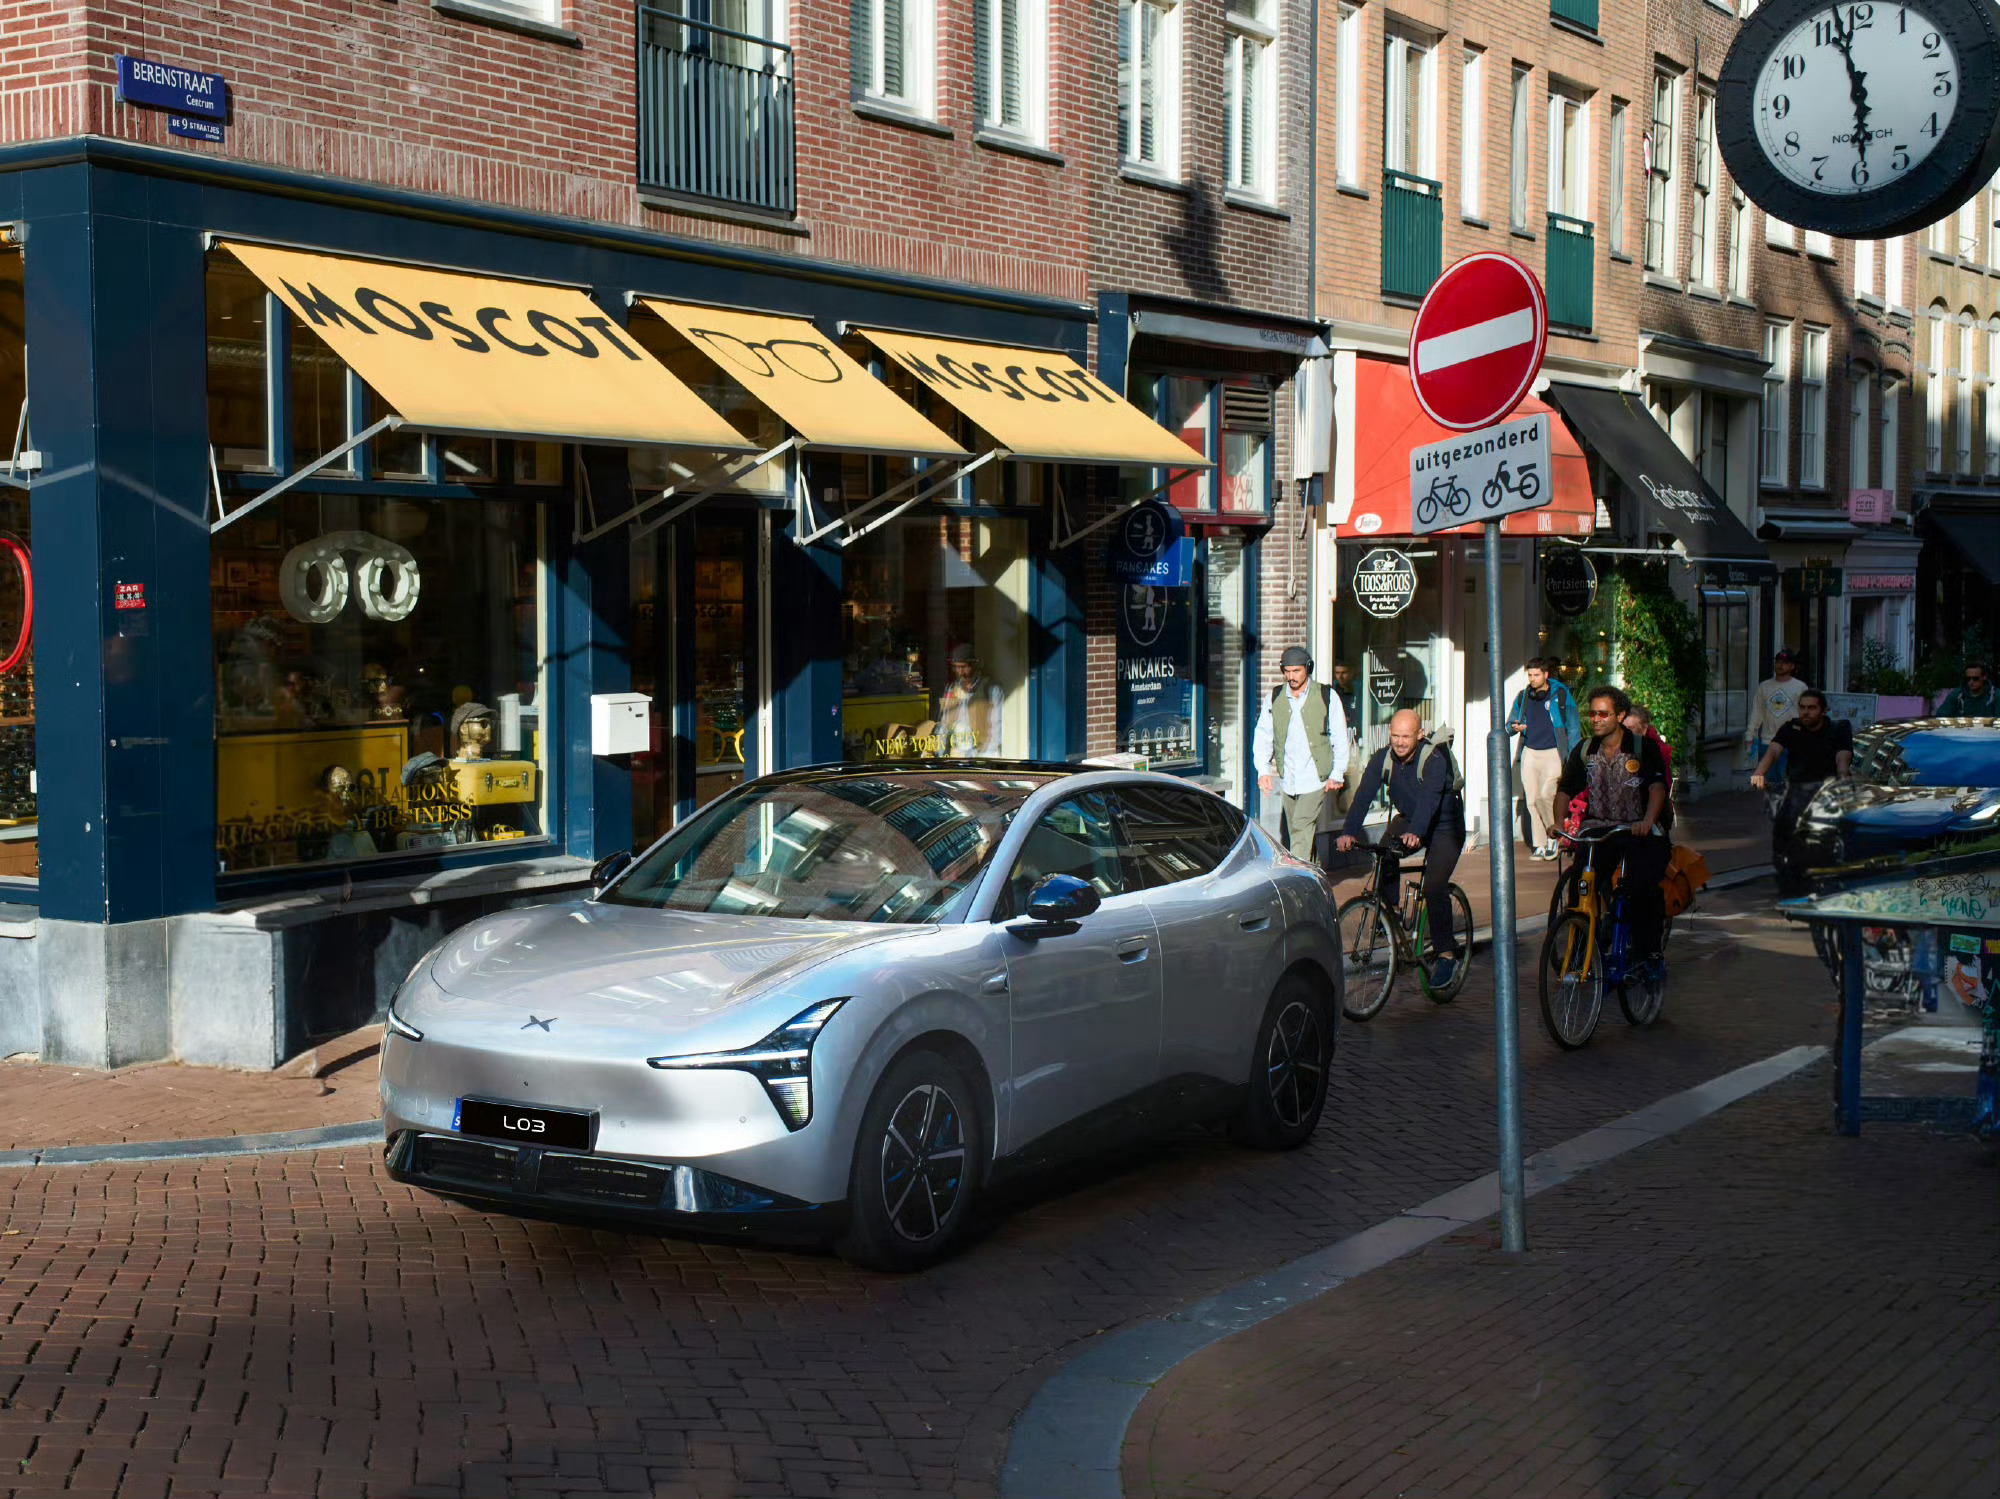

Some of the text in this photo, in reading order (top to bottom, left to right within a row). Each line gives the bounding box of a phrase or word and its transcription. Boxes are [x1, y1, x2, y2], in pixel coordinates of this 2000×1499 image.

[1811, 20, 1833, 47] 11
[1922, 33, 1941, 59] 2
[133, 61, 214, 95] BERENSTRAAT
[1780, 54, 1805, 80] 10
[1933, 70, 1952, 97] 3
[186, 94, 215, 110] Centrum
[1773, 94, 1790, 119] 9
[172, 118, 220, 135] DE 9 STRAATJES
[1832, 128, 1893, 144] NOTCH
[1920, 112, 1942, 138] 4
[1784, 131, 1800, 156] 8
[1810, 156, 1829, 181] 7
[1891, 145, 1910, 170] 5
[1852, 160, 1869, 185] 6
[278, 276, 643, 361] MOSCOT
[892, 349, 1116, 403] MOSCOT
[1416, 422, 1538, 471] uitgezonderd
[1116, 561, 1169, 575] PANCAKES
[1359, 573, 1411, 592] TOOS&ROOS
[1370, 594, 1400, 605] breakfast
[1118, 656, 1174, 680] PANCAKES
[1131, 682, 1162, 691] Amsterdam
[876, 738, 905, 756] NEW
[912, 734, 946, 752] YORK
[375, 803, 473, 829] BUSINESS
